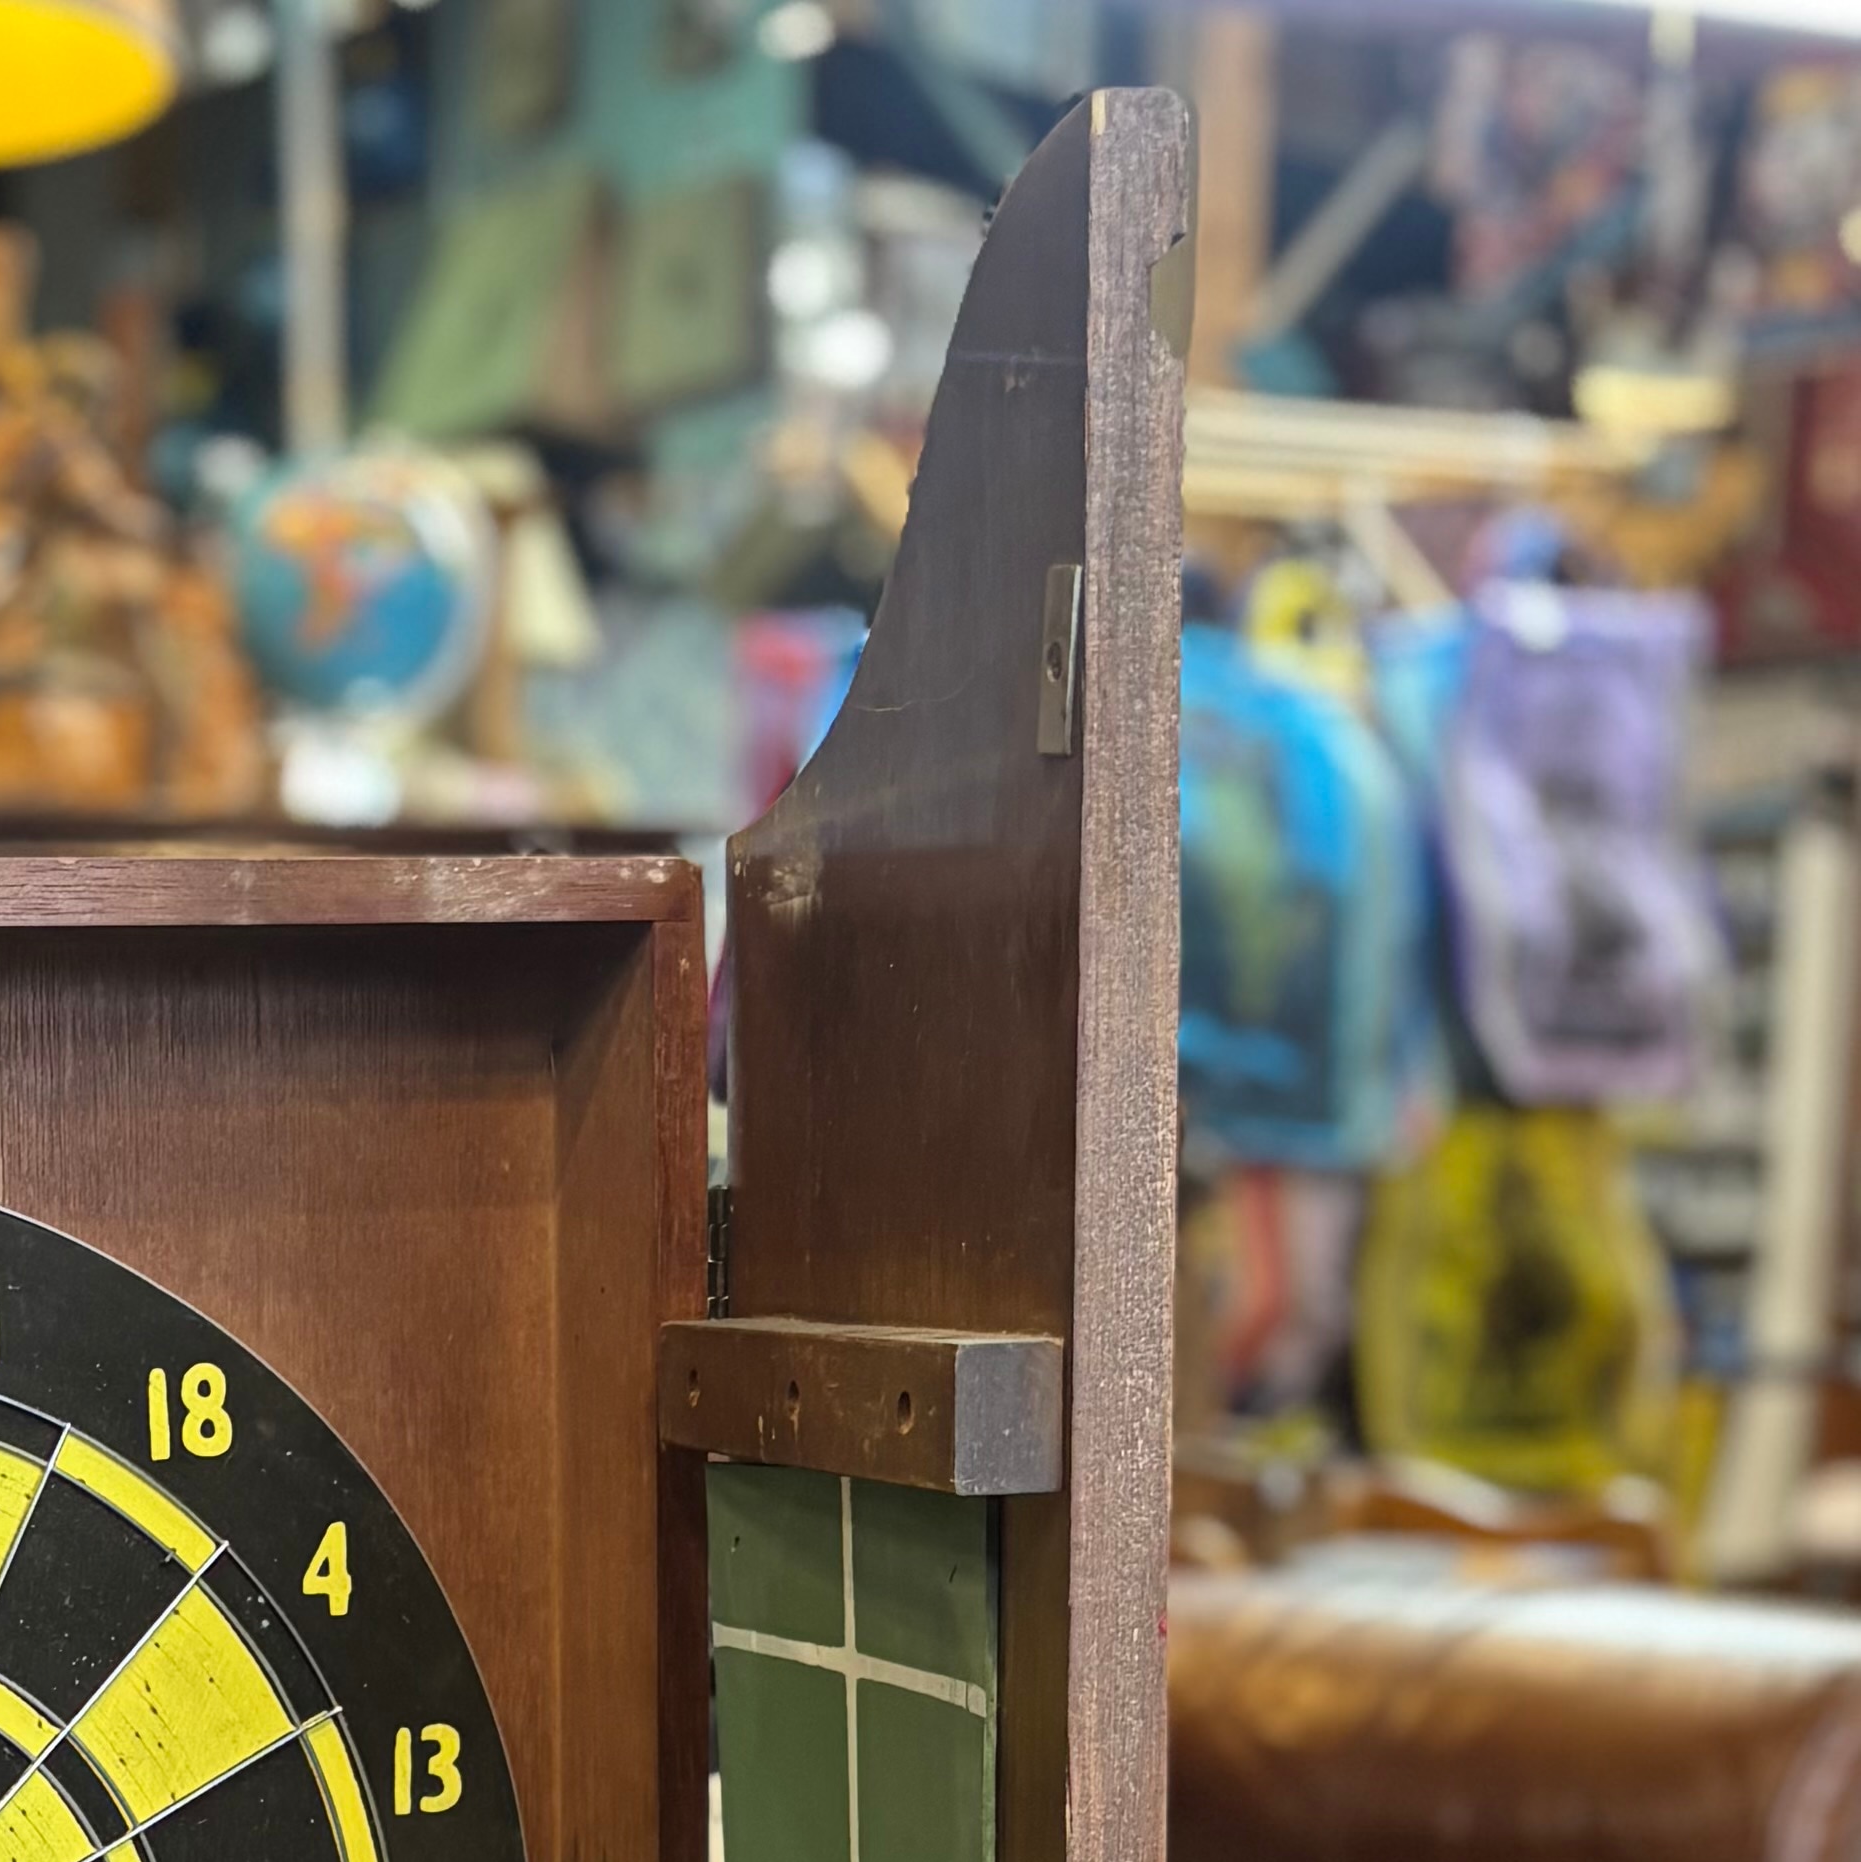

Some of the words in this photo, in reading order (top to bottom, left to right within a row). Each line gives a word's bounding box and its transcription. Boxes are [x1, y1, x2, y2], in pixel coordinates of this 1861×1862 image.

[148, 1362, 232, 1461] 18
[302, 1521, 352, 1616] 4
[394, 1723, 462, 1815] 13
